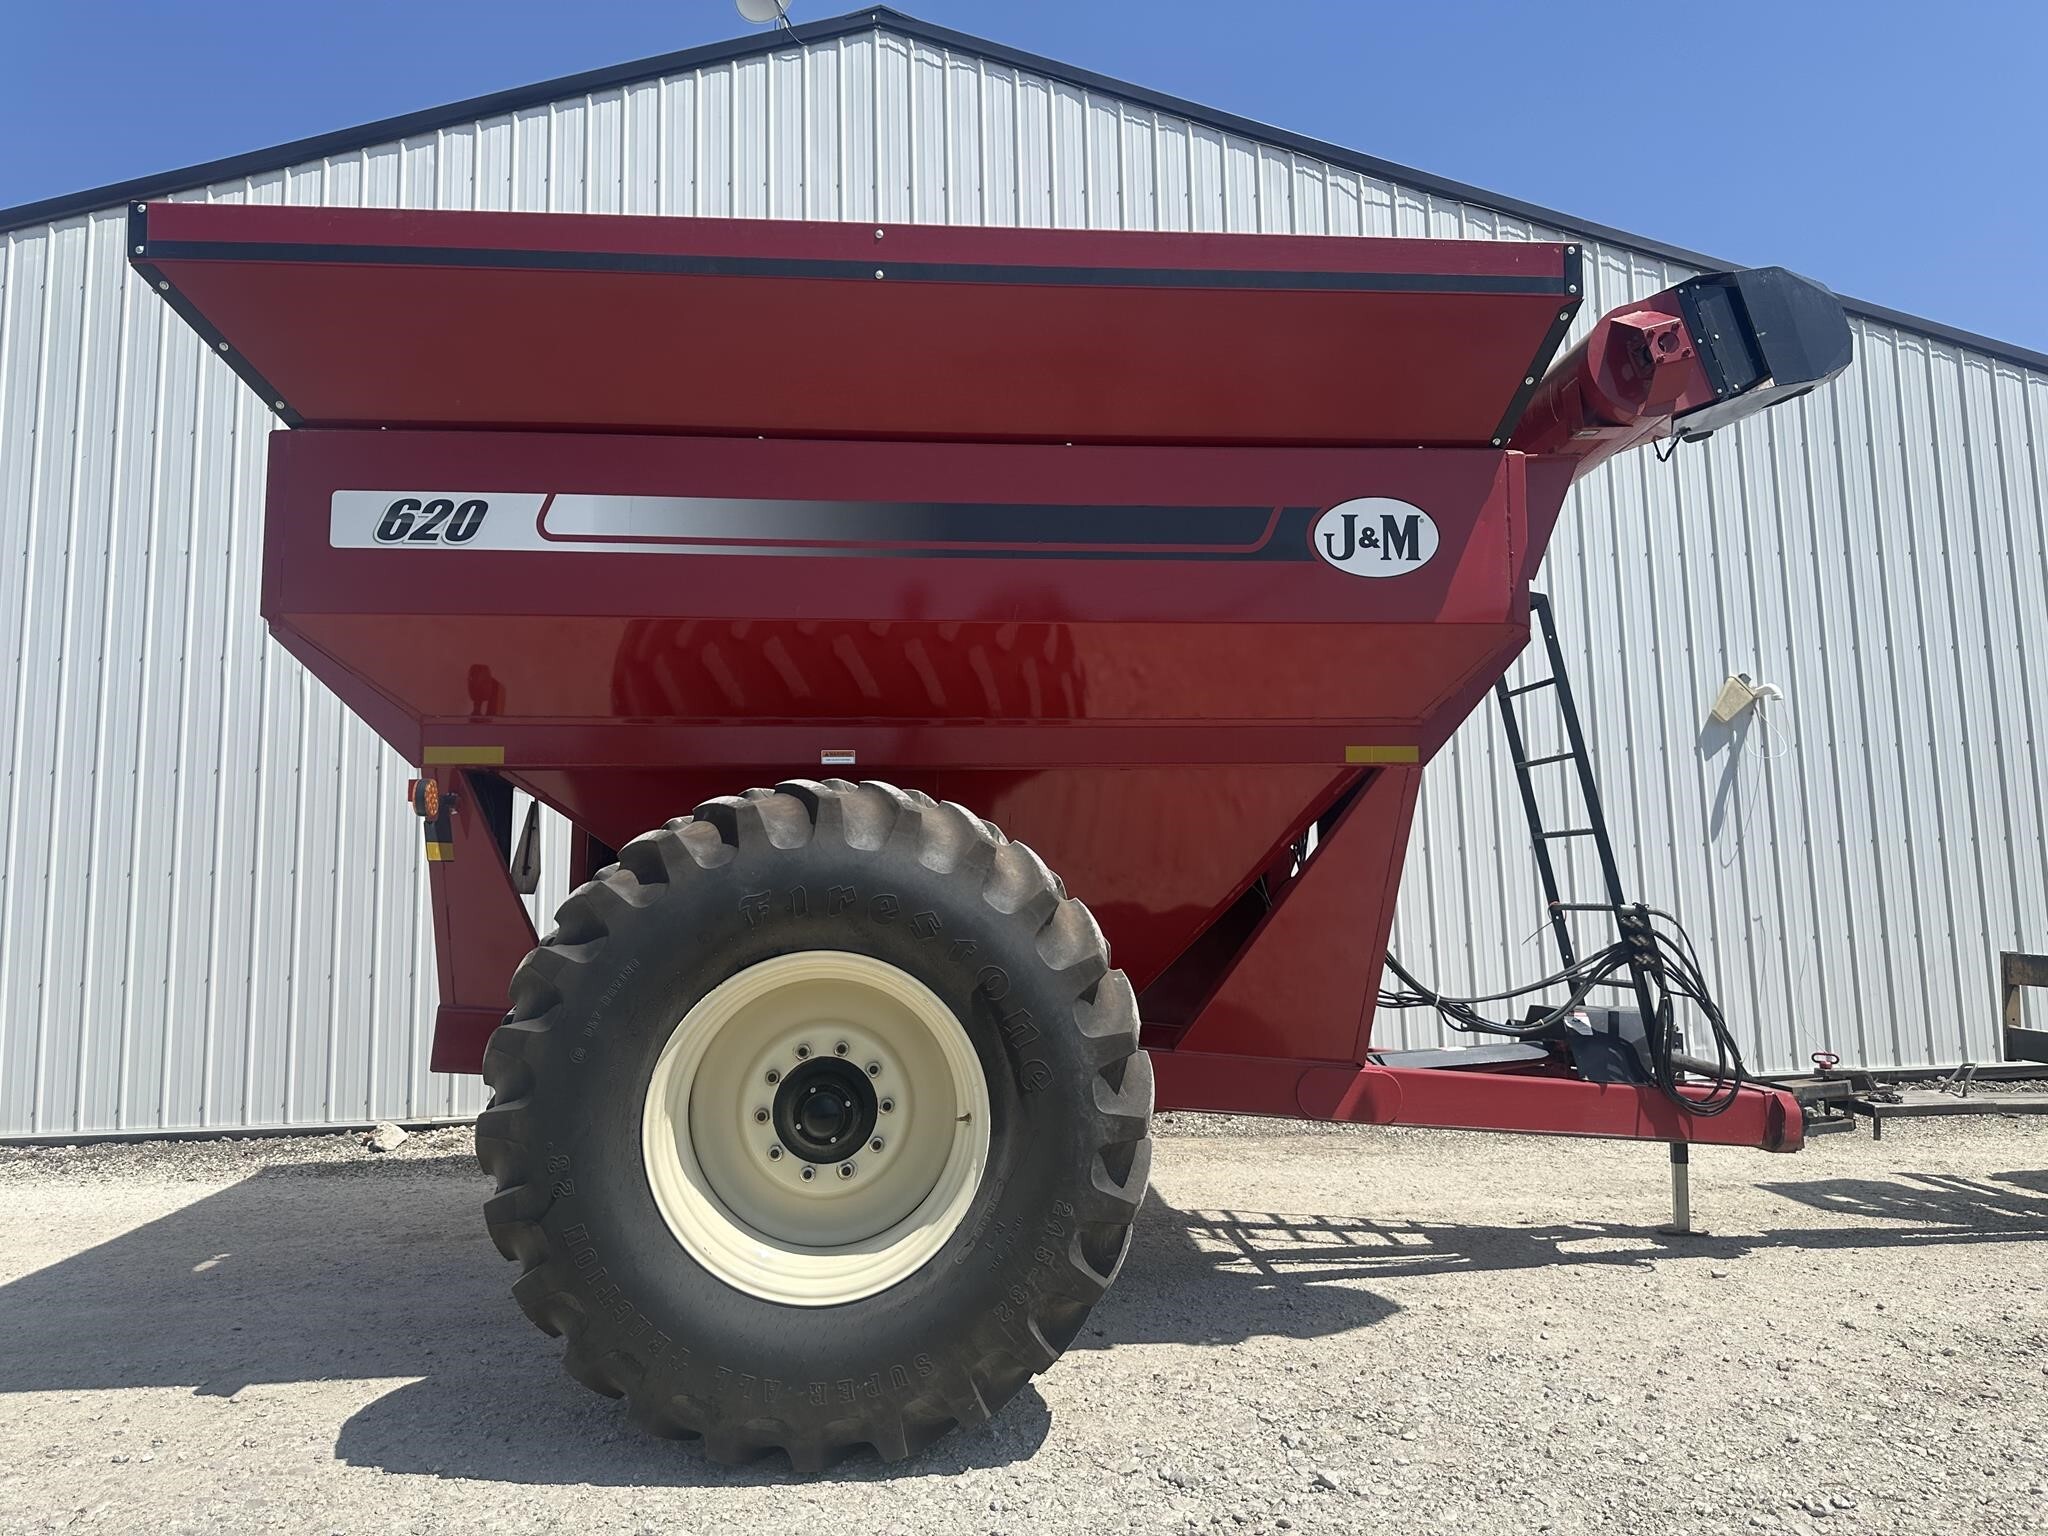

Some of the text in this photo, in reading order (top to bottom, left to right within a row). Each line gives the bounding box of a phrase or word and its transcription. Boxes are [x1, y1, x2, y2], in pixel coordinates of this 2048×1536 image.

[374, 497, 489, 545] 620
[1324, 514, 1422, 561] J&M
[737, 884, 1057, 1095] Firestone
[562, 1222, 693, 1374] TRACTION
[713, 1364, 786, 1405] ALL
[806, 1351, 938, 1406] SUPER
